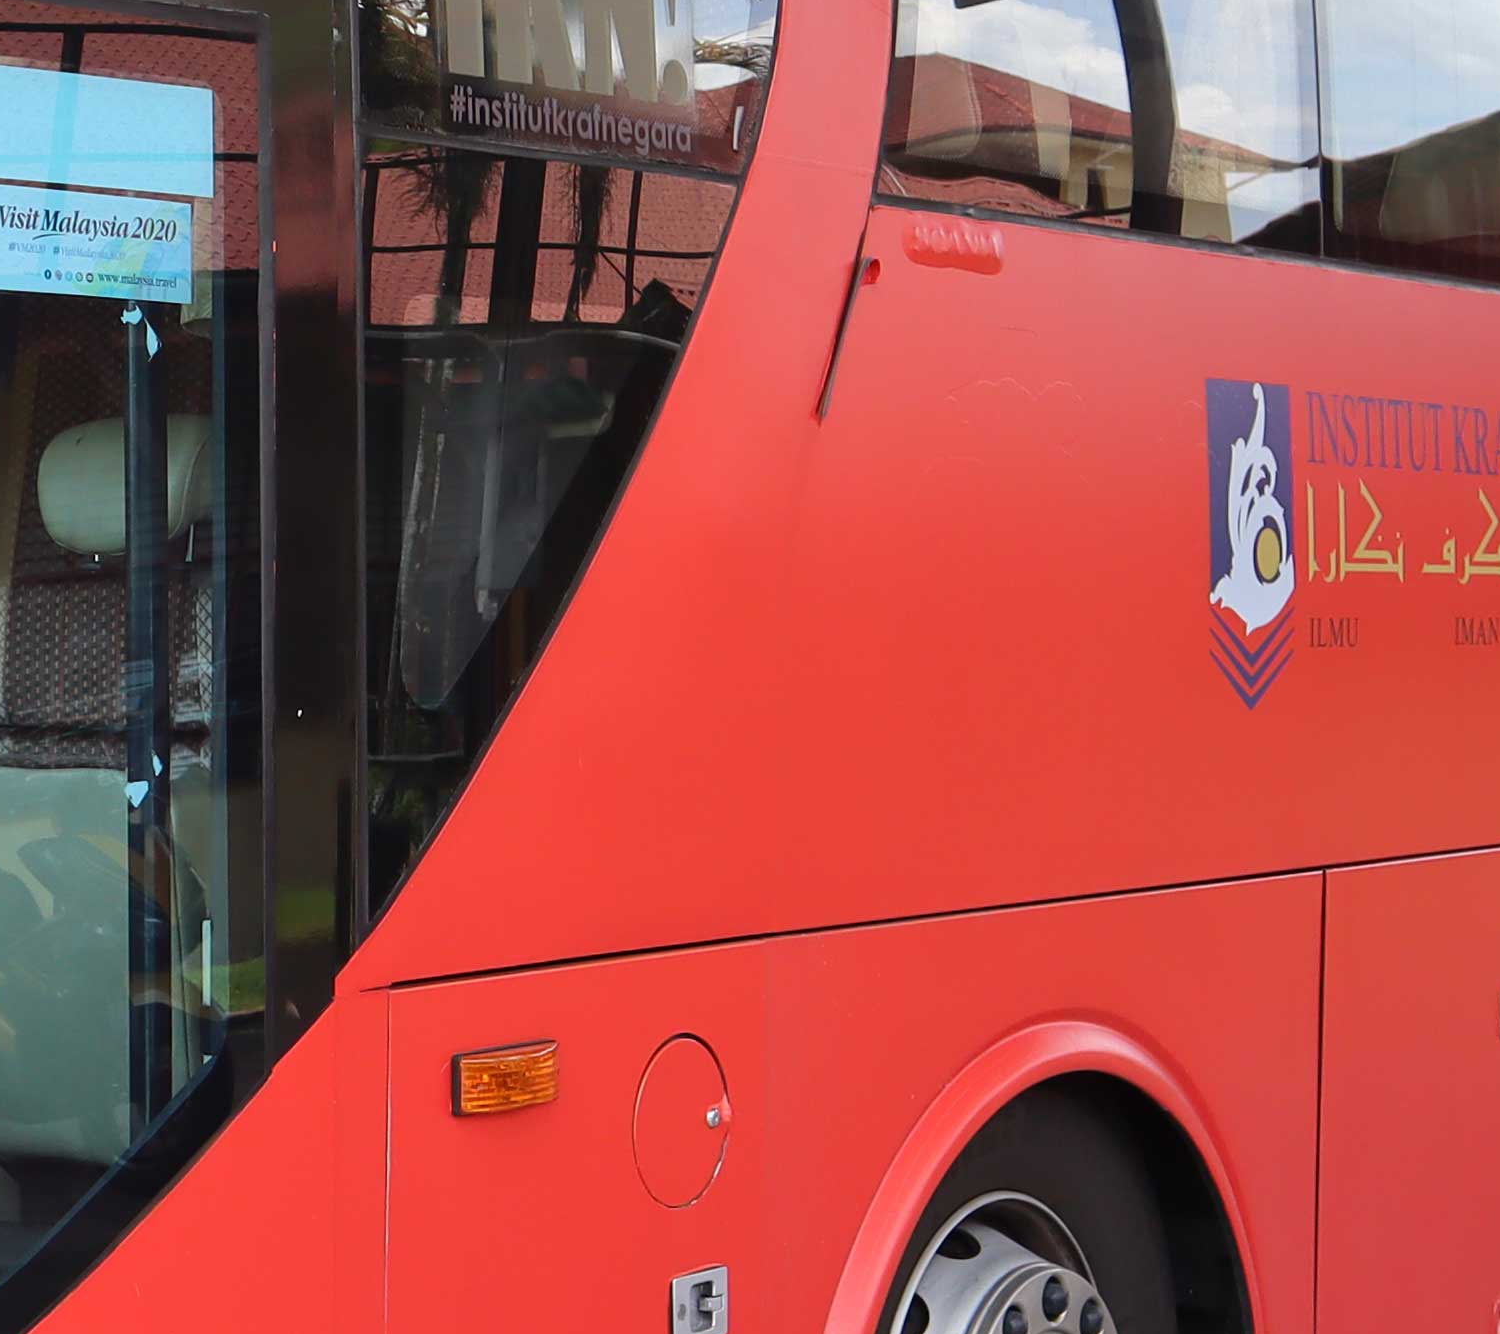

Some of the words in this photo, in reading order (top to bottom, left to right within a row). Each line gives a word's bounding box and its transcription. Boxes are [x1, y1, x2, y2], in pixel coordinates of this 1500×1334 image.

[448, 82, 693, 155] #institutkrafnegara
[41, 208, 130, 242] Malaysia
[131, 216, 178, 244] 2020
[1306, 391, 1443, 472] INSTITUT
[1309, 618, 1359, 648] ILMU
[1454, 616, 1499, 646] IMAN
